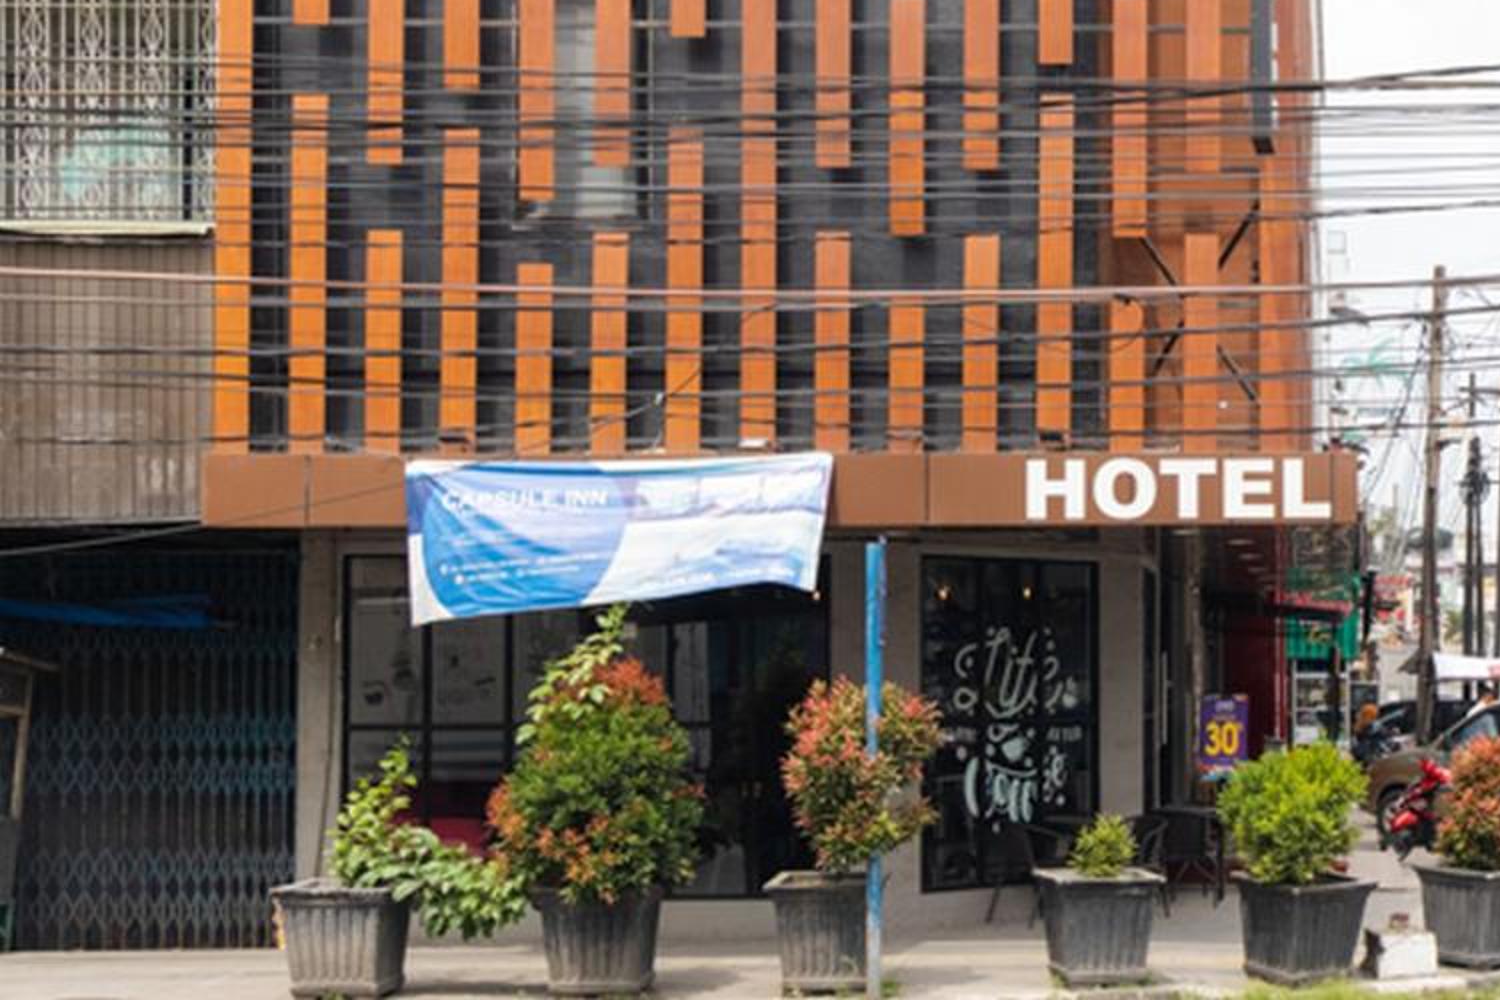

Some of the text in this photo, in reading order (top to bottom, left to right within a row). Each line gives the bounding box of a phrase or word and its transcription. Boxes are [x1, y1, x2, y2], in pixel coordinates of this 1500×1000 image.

[442, 487, 609, 509] CAPSULE INN
[1025, 457, 1332, 520] HOTEL
